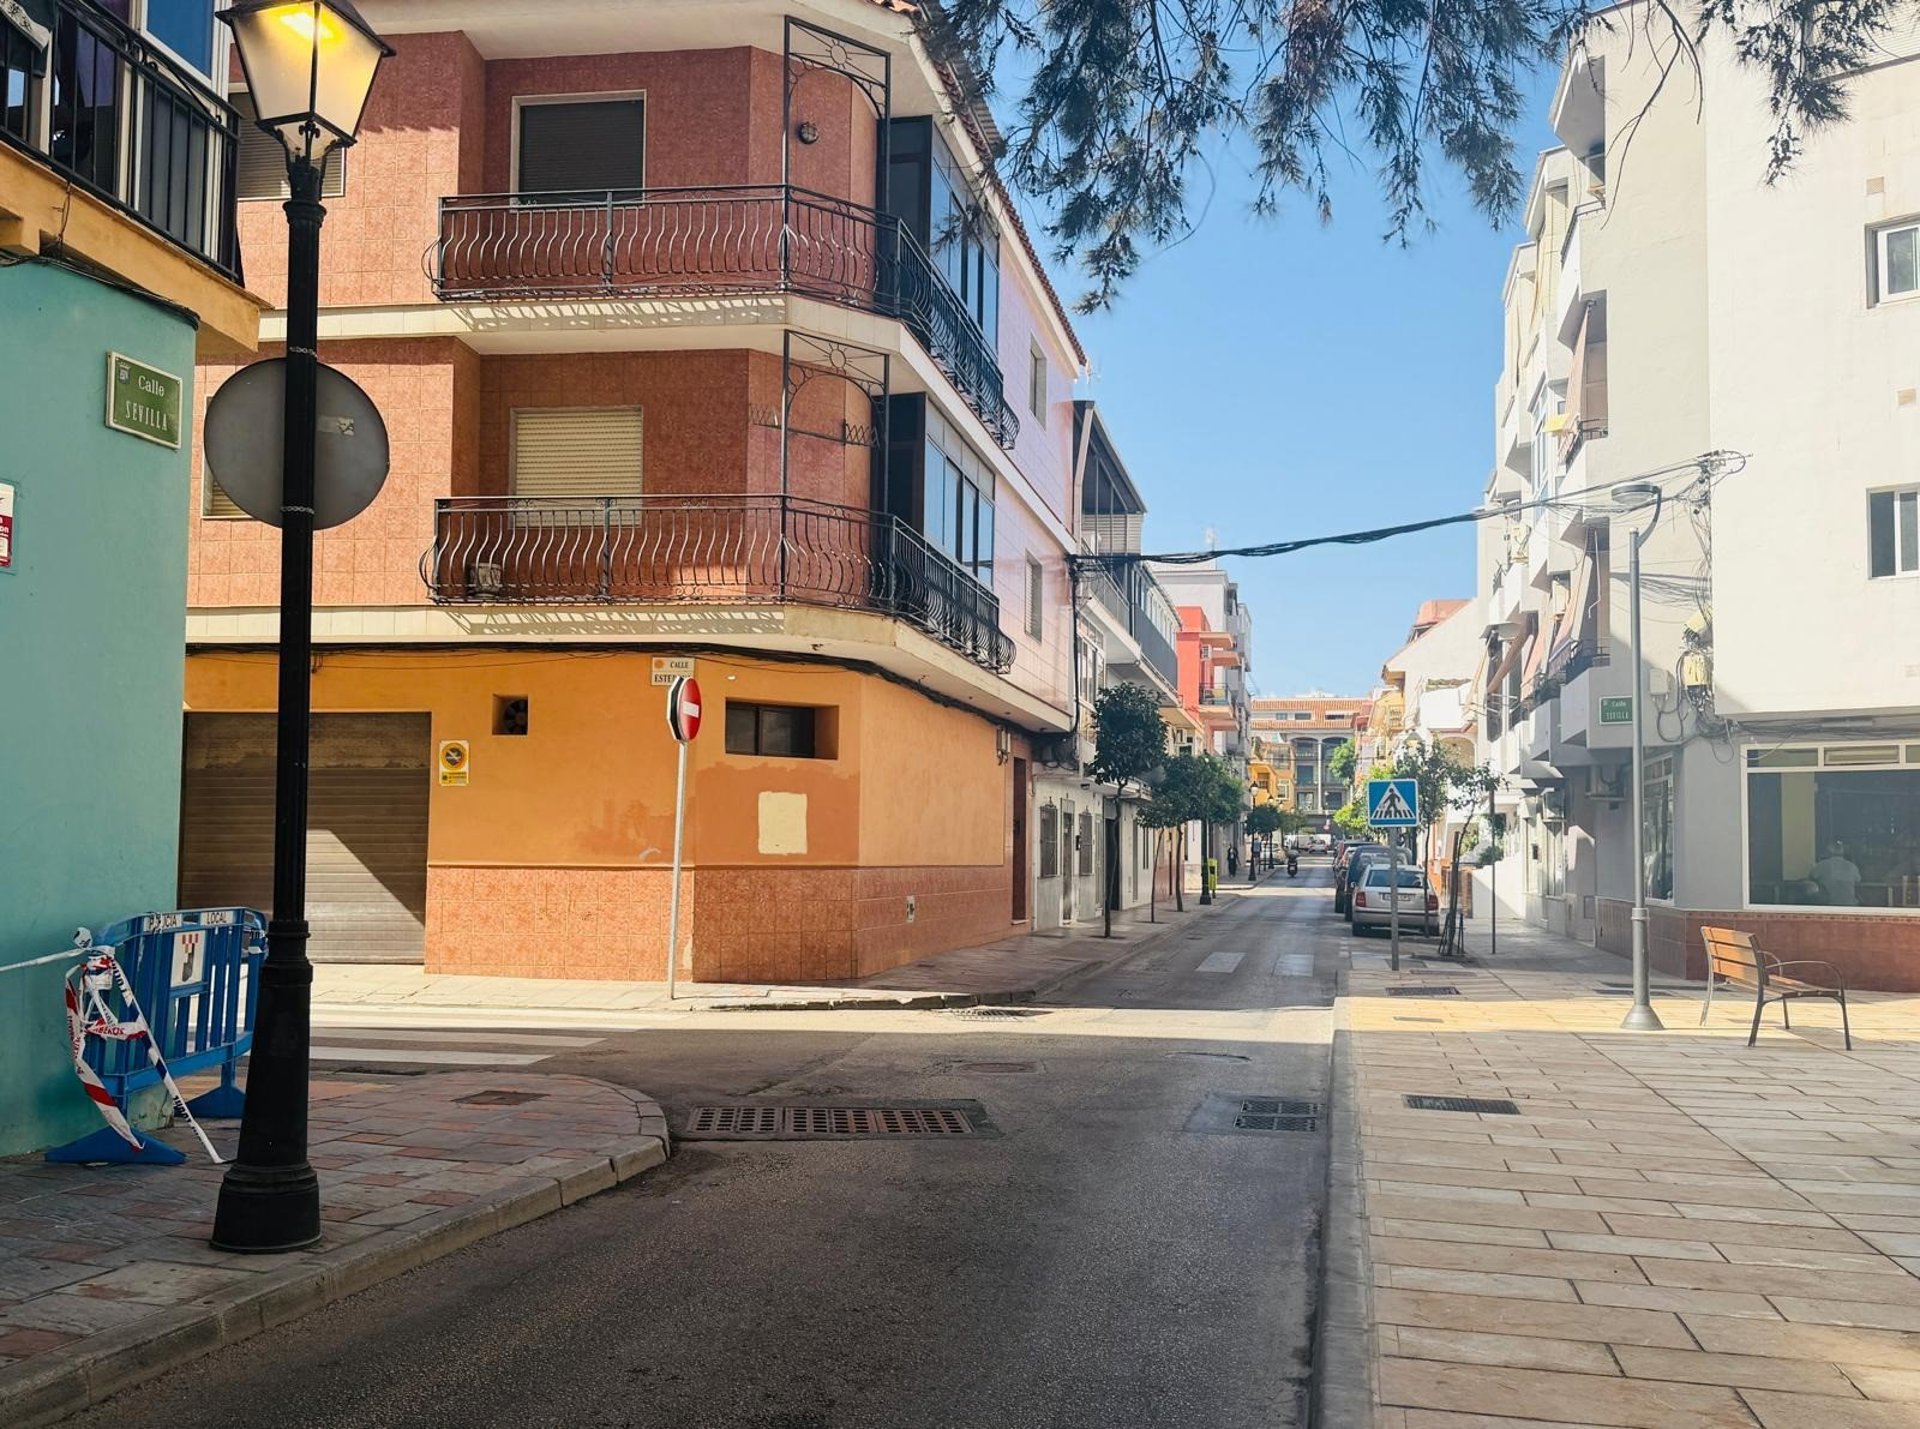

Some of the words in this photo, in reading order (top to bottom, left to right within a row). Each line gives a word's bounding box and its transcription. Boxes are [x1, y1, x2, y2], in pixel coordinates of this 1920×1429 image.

[138, 375, 165, 397] Calle
[125, 400, 168, 431] SEVILLA
[206, 911, 227, 925] LOCAL
